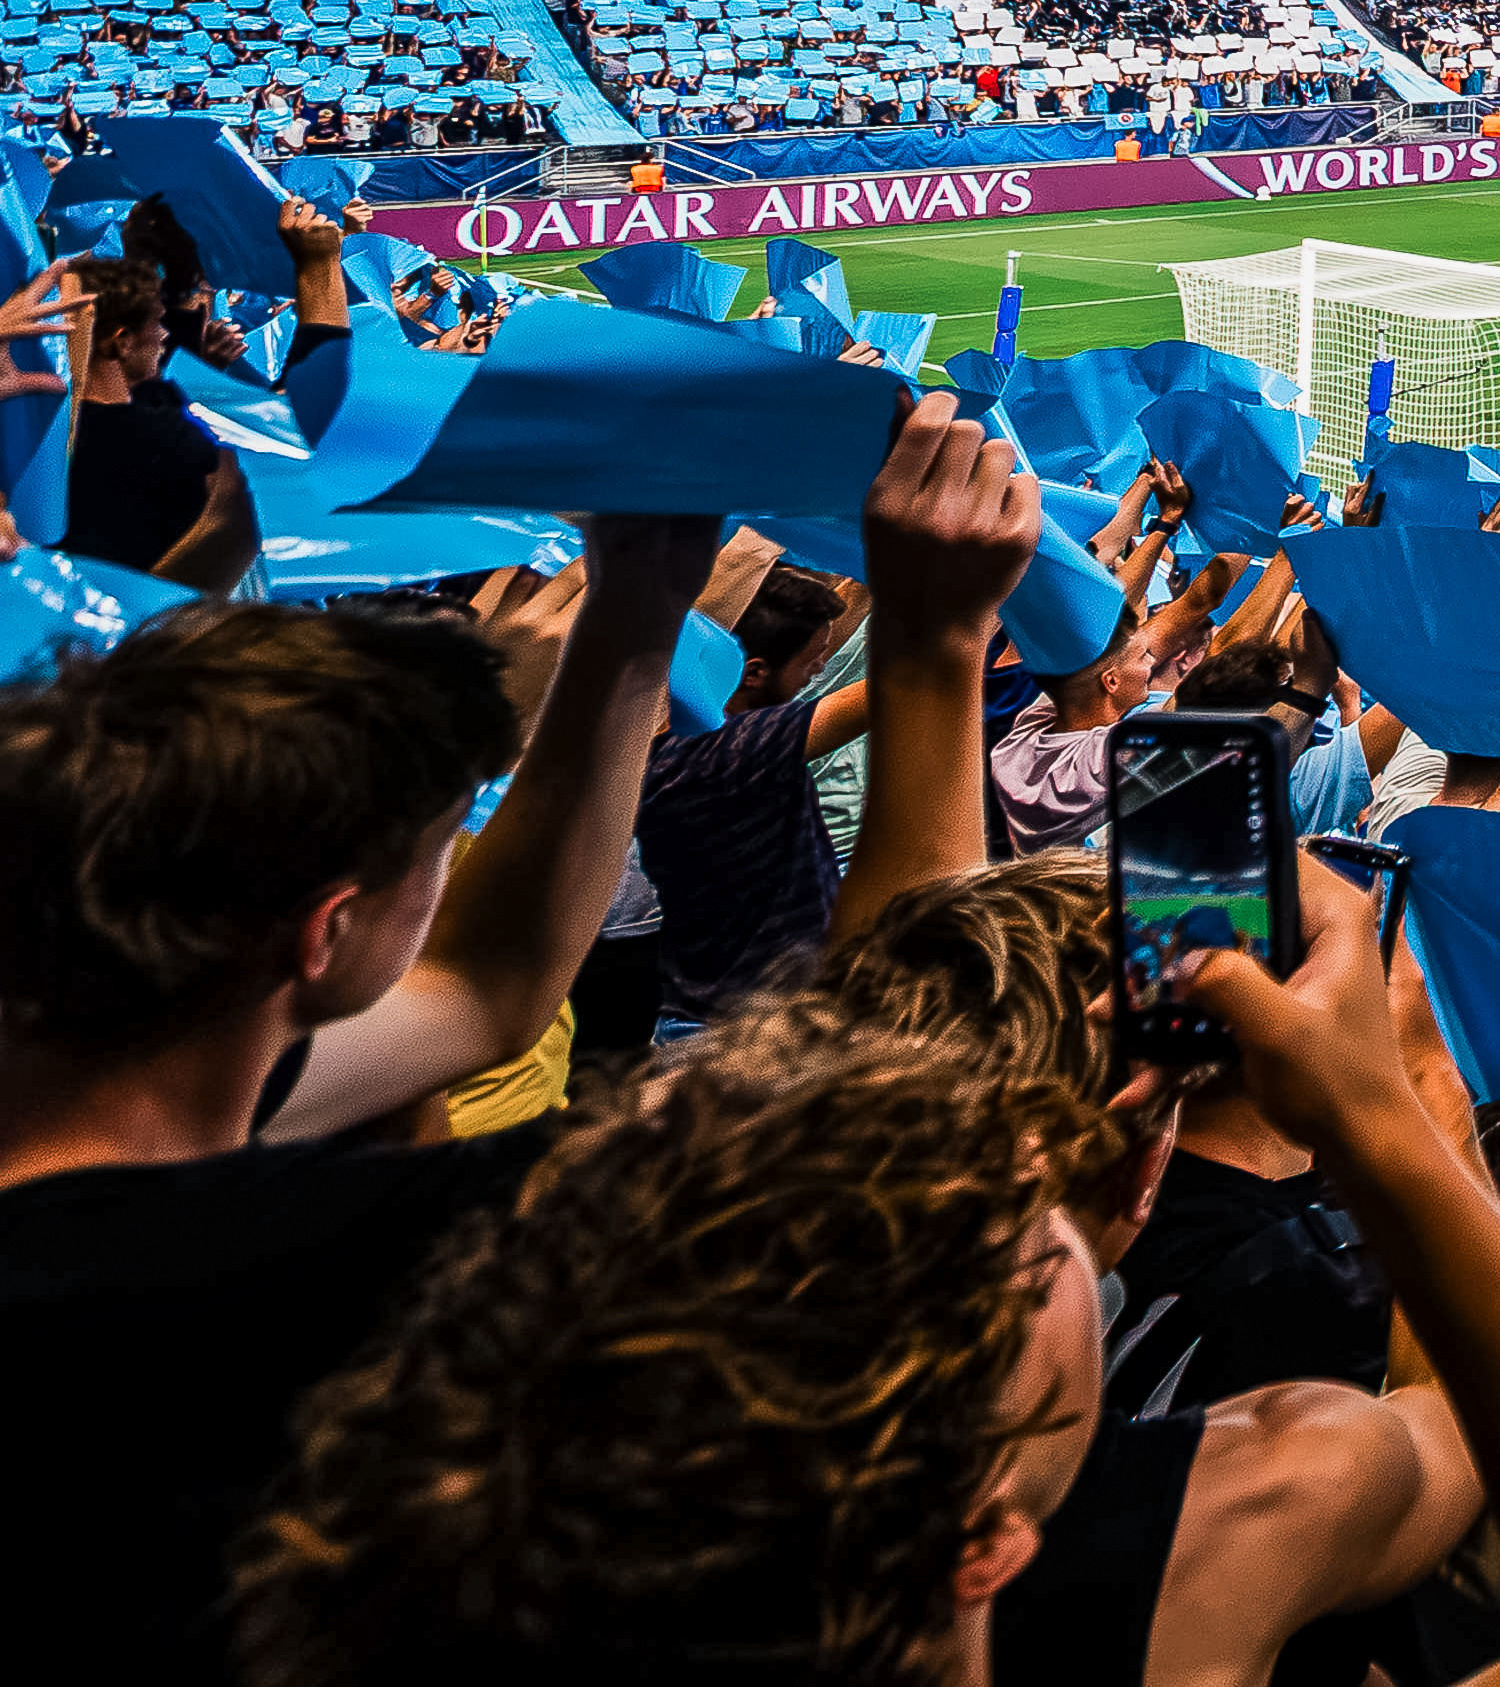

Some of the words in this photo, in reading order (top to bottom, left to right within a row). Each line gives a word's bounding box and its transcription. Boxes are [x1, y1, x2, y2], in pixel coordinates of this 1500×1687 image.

[1260, 137, 1498, 193] WORLD'S
[456, 192, 718, 256] QATAR
[748, 171, 1033, 233] AIRWAYS
